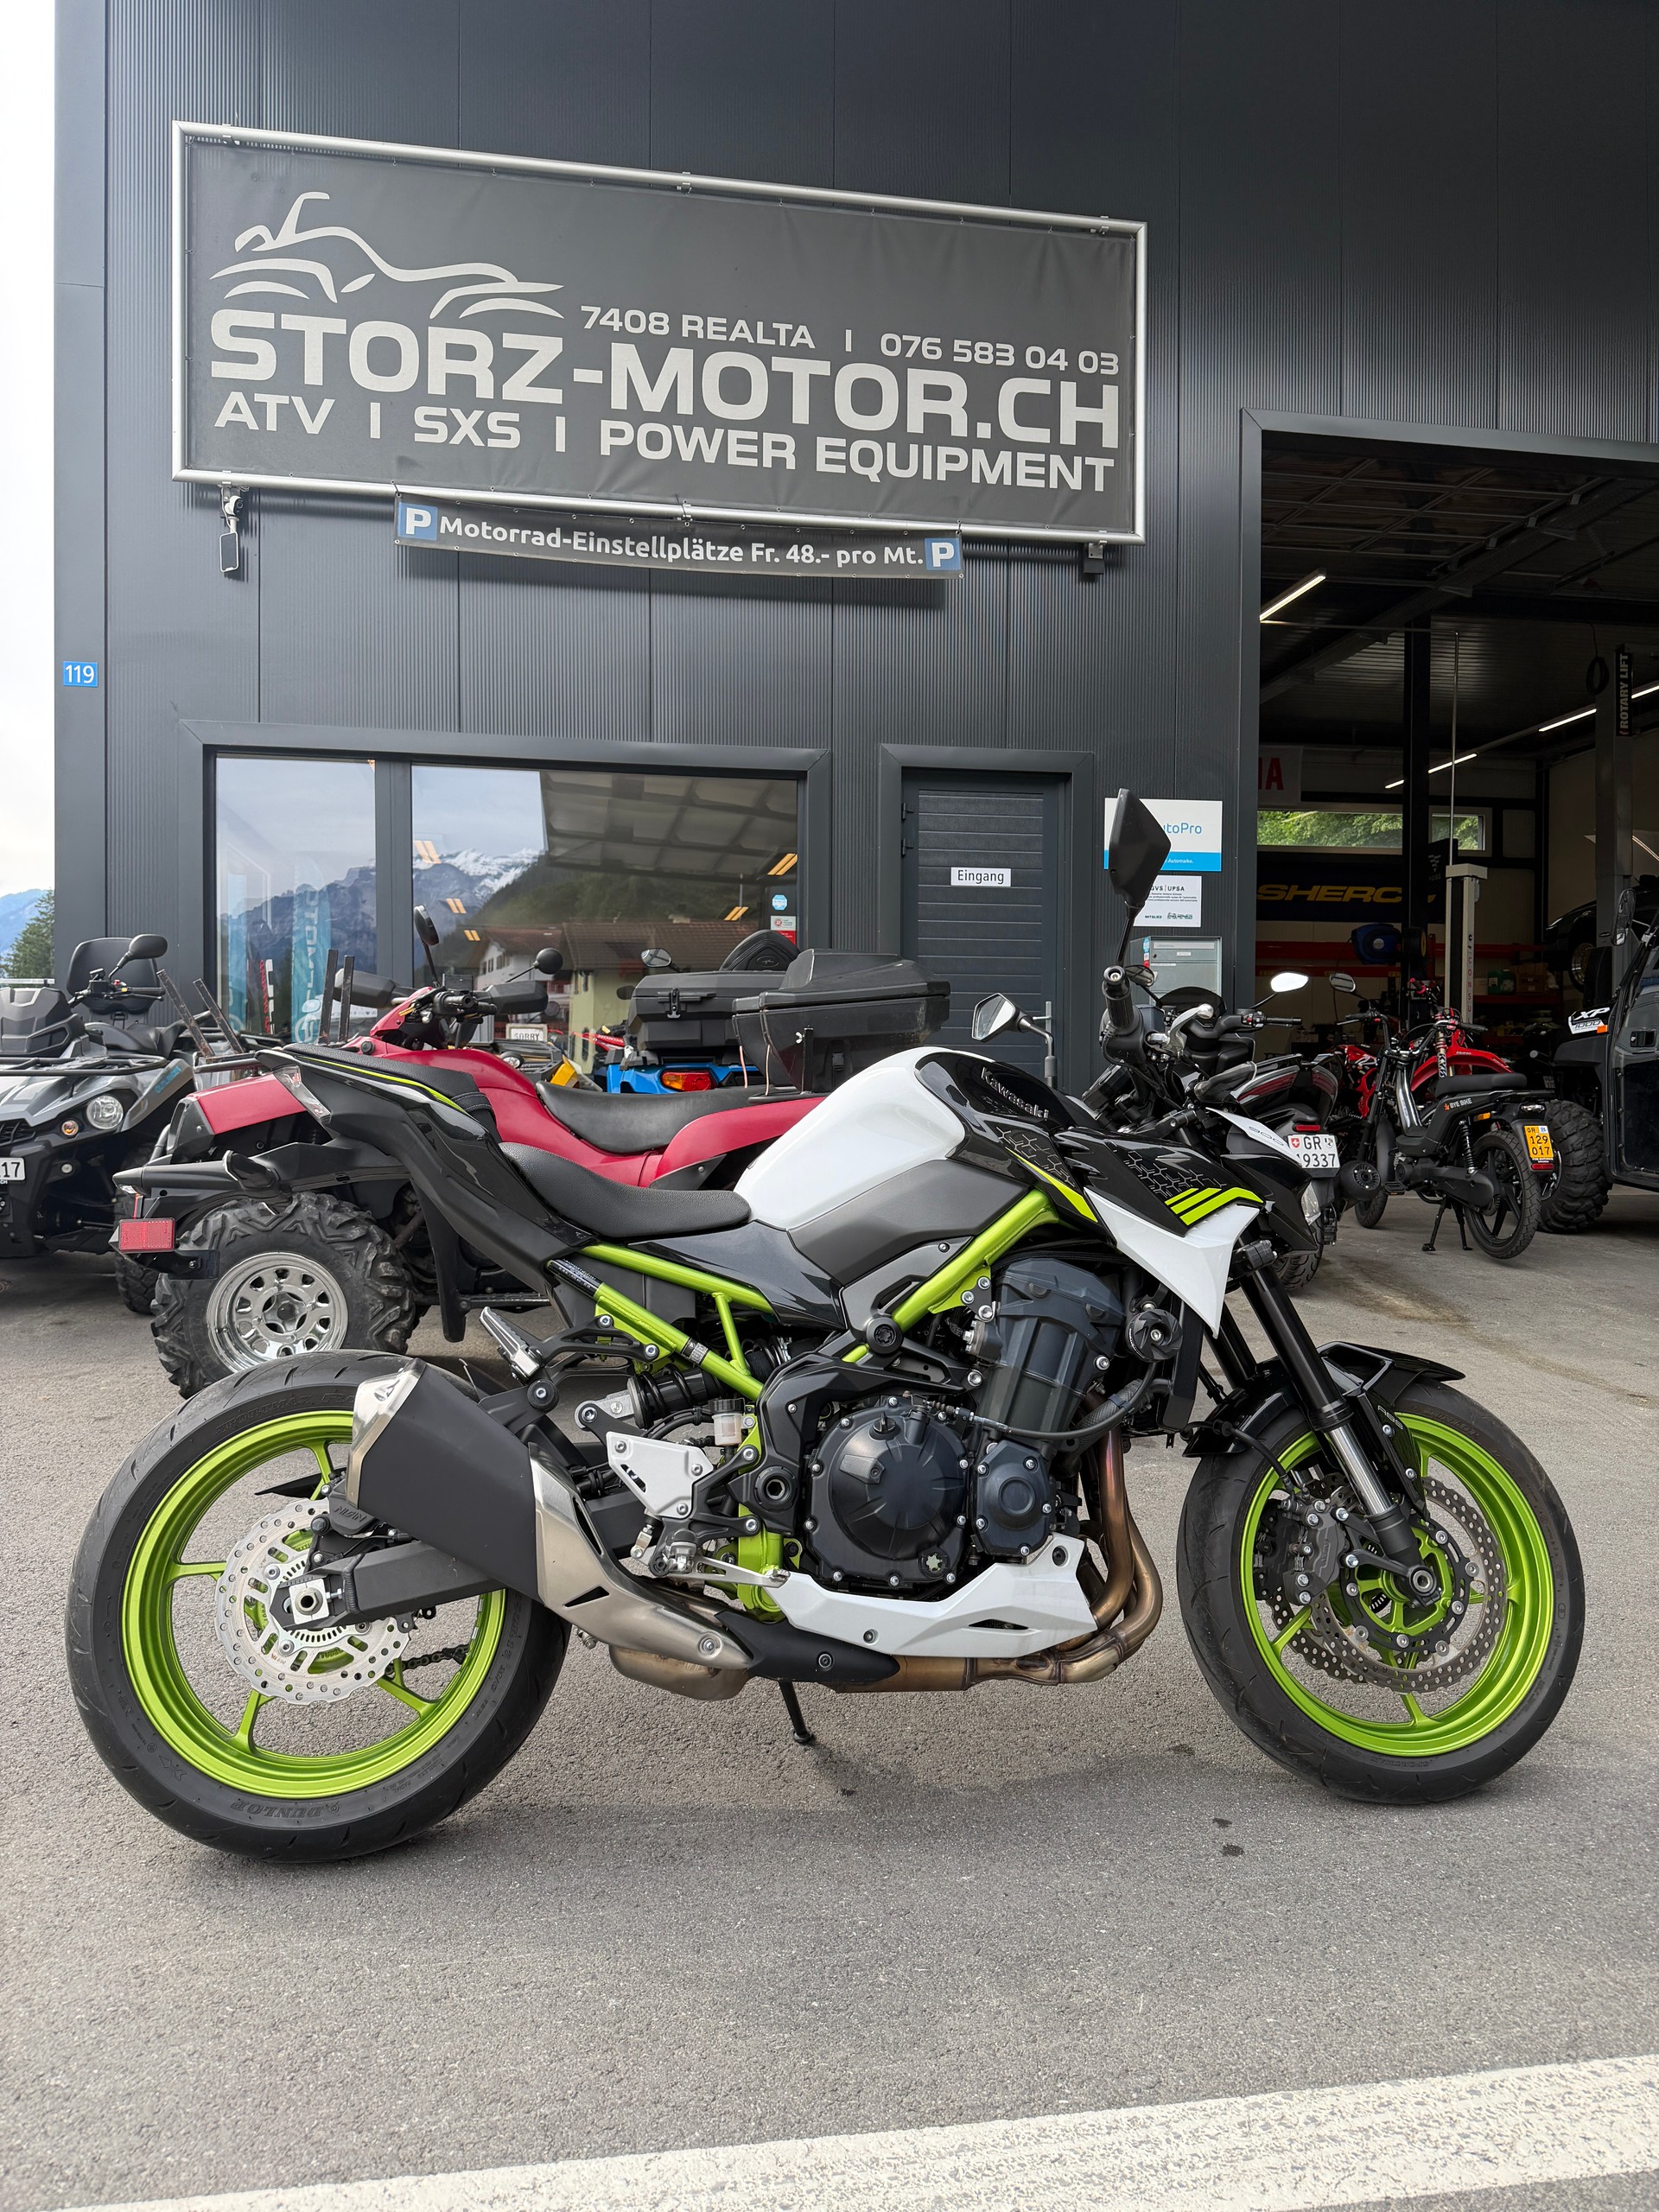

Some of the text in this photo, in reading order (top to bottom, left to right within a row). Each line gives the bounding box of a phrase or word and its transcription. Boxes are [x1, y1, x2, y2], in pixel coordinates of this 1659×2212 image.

[581, 305, 670, 335] 7408
[682, 314, 816, 349] REALTA
[880, 333, 943, 360] 076
[953, 339, 1015, 366] 583
[1025, 346, 1069, 372] 04
[1078, 350, 1119, 375] 03
[210, 308, 1119, 449] STORZ-MOTOR.CH
[213, 391, 336, 435] ATV
[413, 405, 521, 449] SXS
[600, 419, 796, 470] POWER
[816, 435, 1115, 493] EQUIPMENT
[405, 506, 955, 568] P Motorrad-Einstellplätze Fr. 48.- pro Mt. P
[65, 664, 95, 684] 119
[1619, 653, 1629, 728] ROTARY LIFT
[1163, 822, 1202, 835] toPro
[957, 869, 1005, 885] Eingang
[1257, 884, 1436, 904] SHERC
[1573, 1007, 1610, 1021] XP
[1574, 1020, 1601, 1029] 1000
[981, 1066, 1050, 1120] Kawasaki
[1460, 1097, 1472, 1106] BIKE
[1303, 1136, 1322, 1150] GR
[1529, 1135, 1548, 1145] 129
[1531, 1146, 1550, 1156] 017
[1297, 1154, 1336, 1167] 9337
[230, 1801, 325, 1819] DUNLOP
